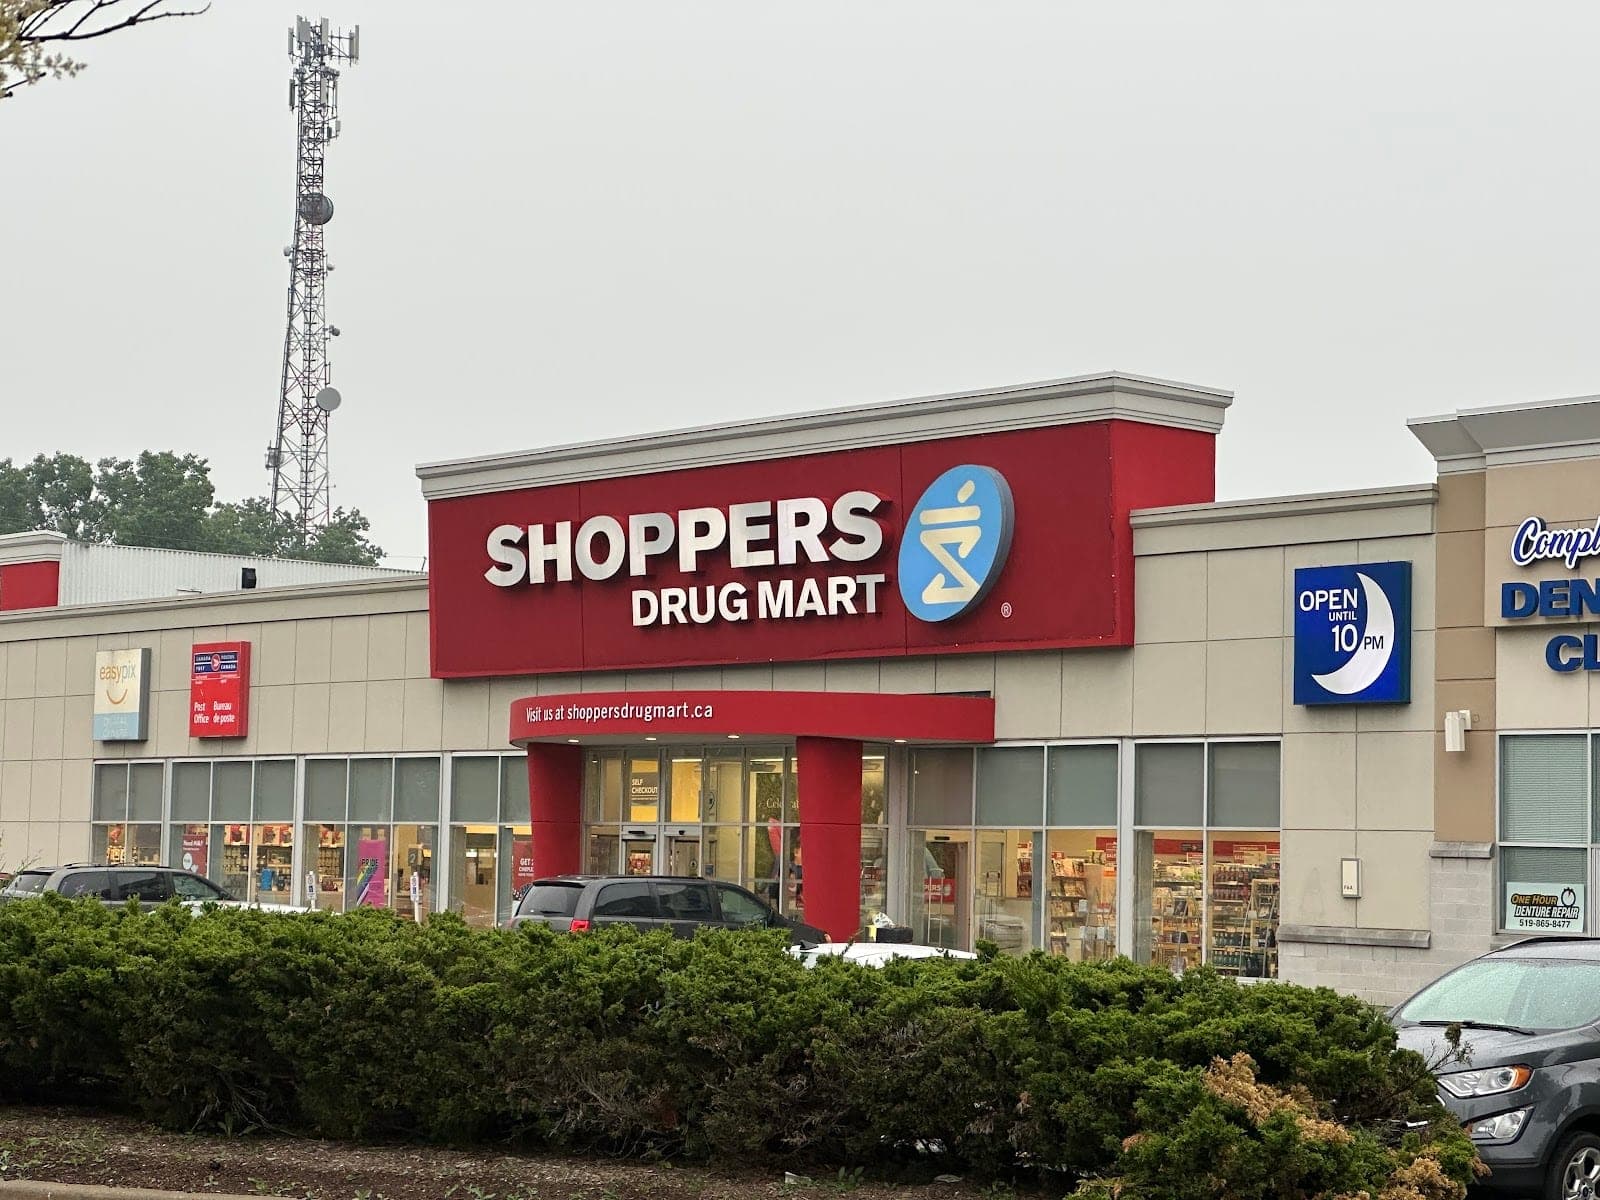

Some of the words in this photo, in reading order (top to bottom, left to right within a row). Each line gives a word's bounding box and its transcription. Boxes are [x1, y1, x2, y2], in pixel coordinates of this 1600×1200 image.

[484, 490, 883, 587] SHOPPERS
[632, 582, 748, 627] DRUG
[758, 573, 885, 620] MART
[1299, 588, 1358, 611] OPEN
[1500, 578, 1600, 619] DEN
[1328, 611, 1358, 621] UNTIL
[1331, 623, 1358, 652] 10
[1364, 635, 1384, 650] PM
[1545, 634, 1600, 673] CL
[100, 660, 136, 684] easypix
[194, 702, 206, 712] Post
[213, 701, 232, 711] Bureau
[526, 706, 542, 723] Visit
[544, 709, 554, 721] us
[555, 705, 564, 720] at
[567, 702, 713, 722] shoppersdrugmart.ca
[193, 714, 210, 724] Office
[213, 713, 220, 723] de
[220, 714, 235, 725] poste
[632, 778, 643, 786] SELF
[632, 786, 658, 794] CHECKOUT
[361, 858, 379, 867] PRIDE
[1511, 894, 1530, 905] ONE
[1532, 895, 1558, 905] HOUR
[1515, 906, 1551, 917] DENTURE
[1551, 907, 1579, 919] REPAIR
[1519, 919, 1571, 928] 519-865-8477
